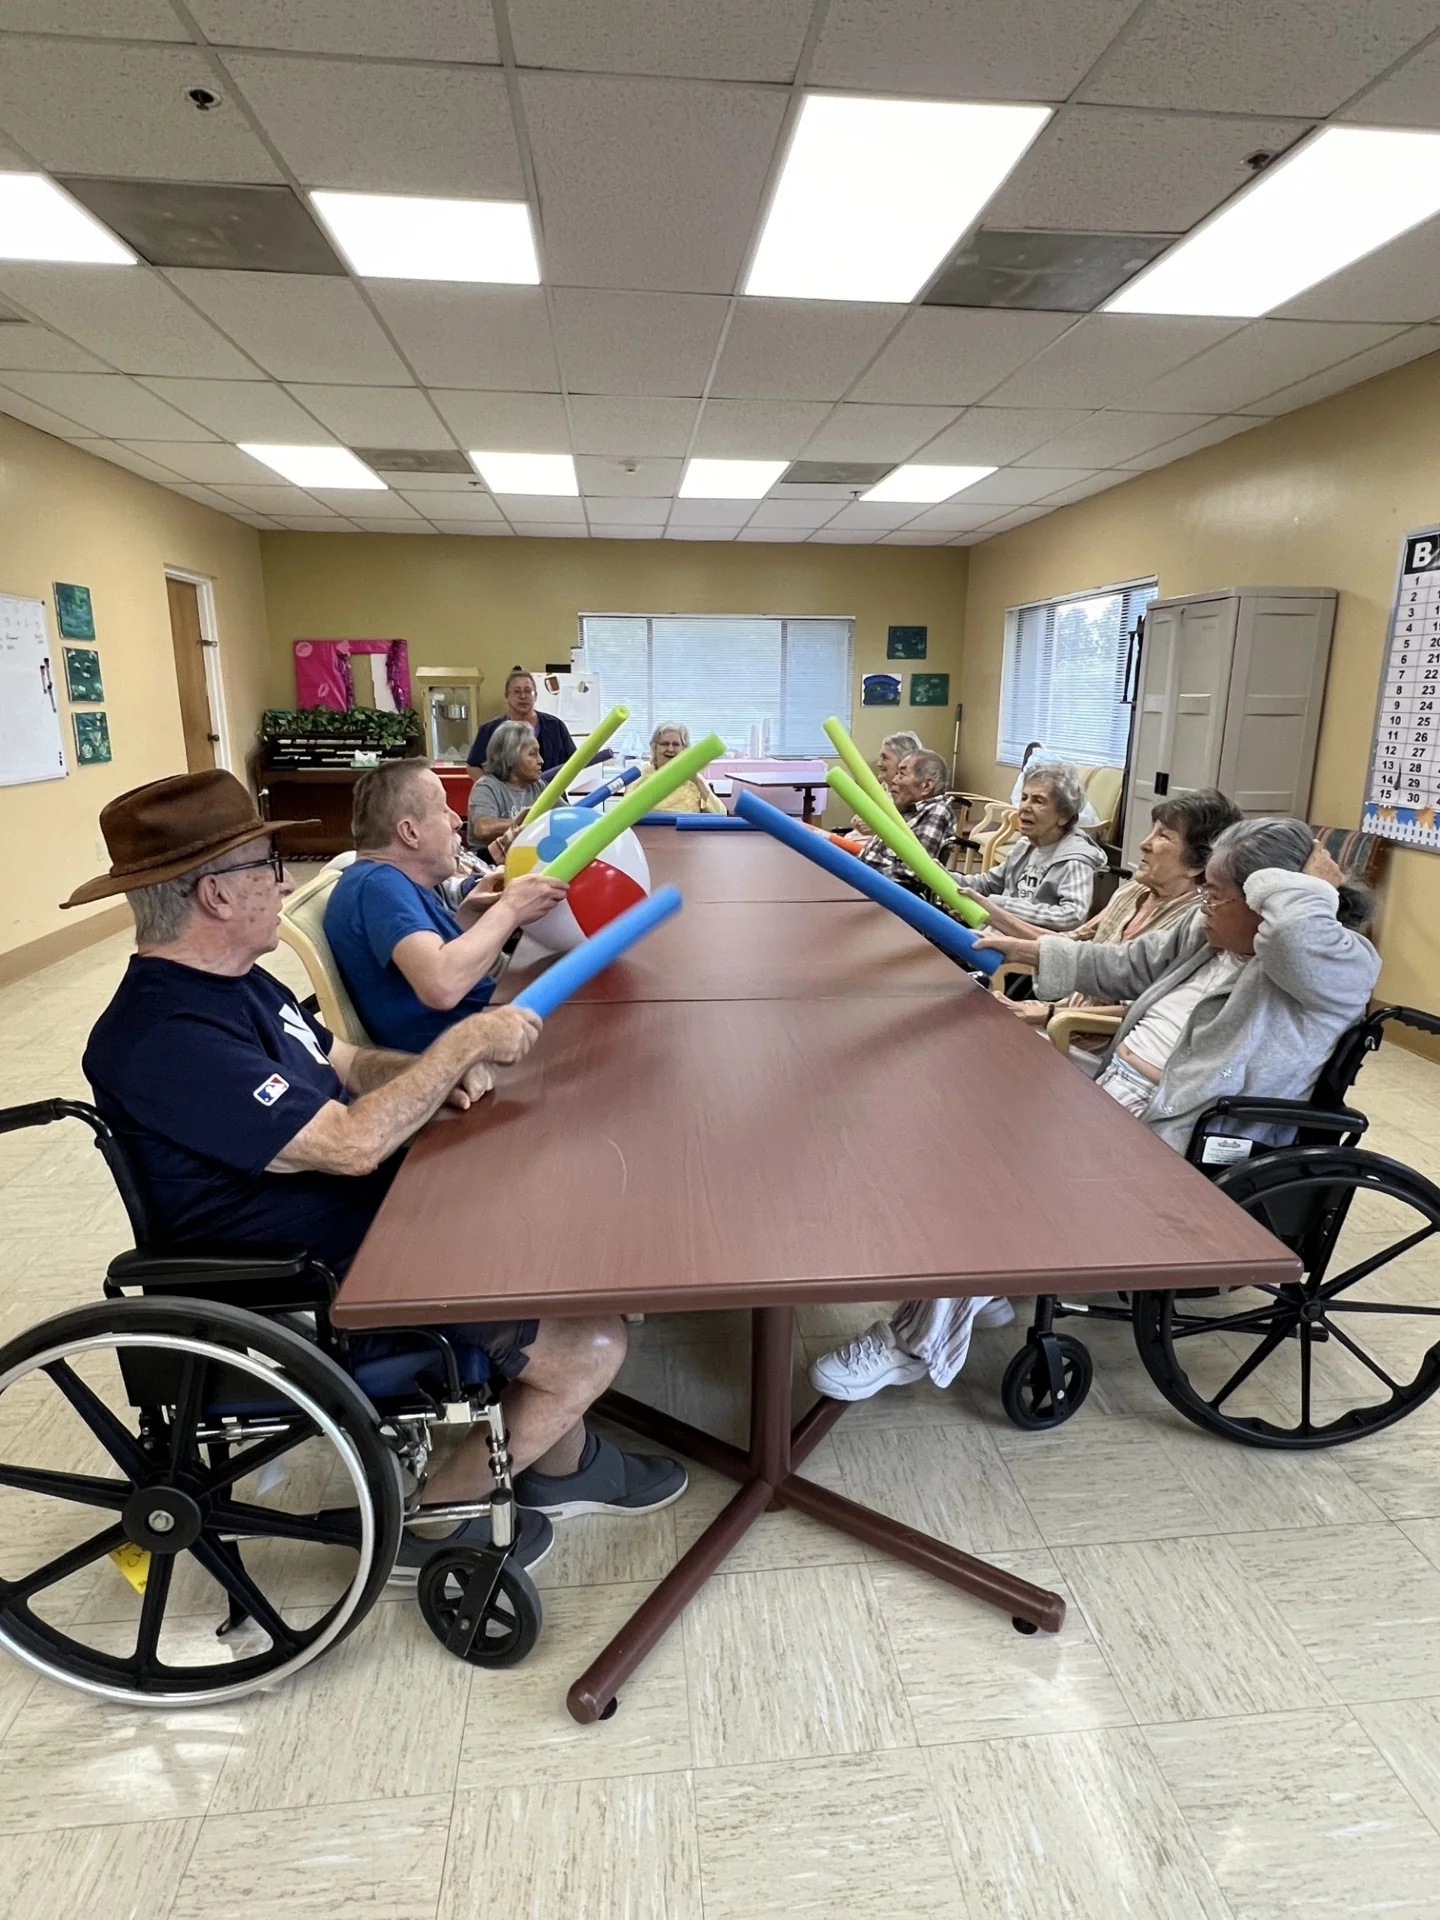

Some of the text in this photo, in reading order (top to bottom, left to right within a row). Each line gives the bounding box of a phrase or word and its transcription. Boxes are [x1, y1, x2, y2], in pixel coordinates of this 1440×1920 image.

[1412, 541, 1432, 568] B
[1415, 576, 1420, 585] 1
[1410, 592, 1417, 601] 2
[1408, 608, 1414, 617] 3
[1406, 623, 1412, 632] 4
[1404, 639, 1410, 648] 5
[1401, 653, 1440, 664] 6 21
[1399, 669, 1438, 679] 7 22
[1396, 685, 1435, 695] 8 23
[1394, 701, 1433, 710] 9 24
[1390, 716, 1431, 726] 10 25
[1388, 731, 1428, 742] 11 26
[1385, 745, 1426, 757] 12 27
[1382, 761, 1422, 773] 13 28
[1381, 775, 1420, 788] 14 29
[1380, 789, 1420, 803] 15 30
